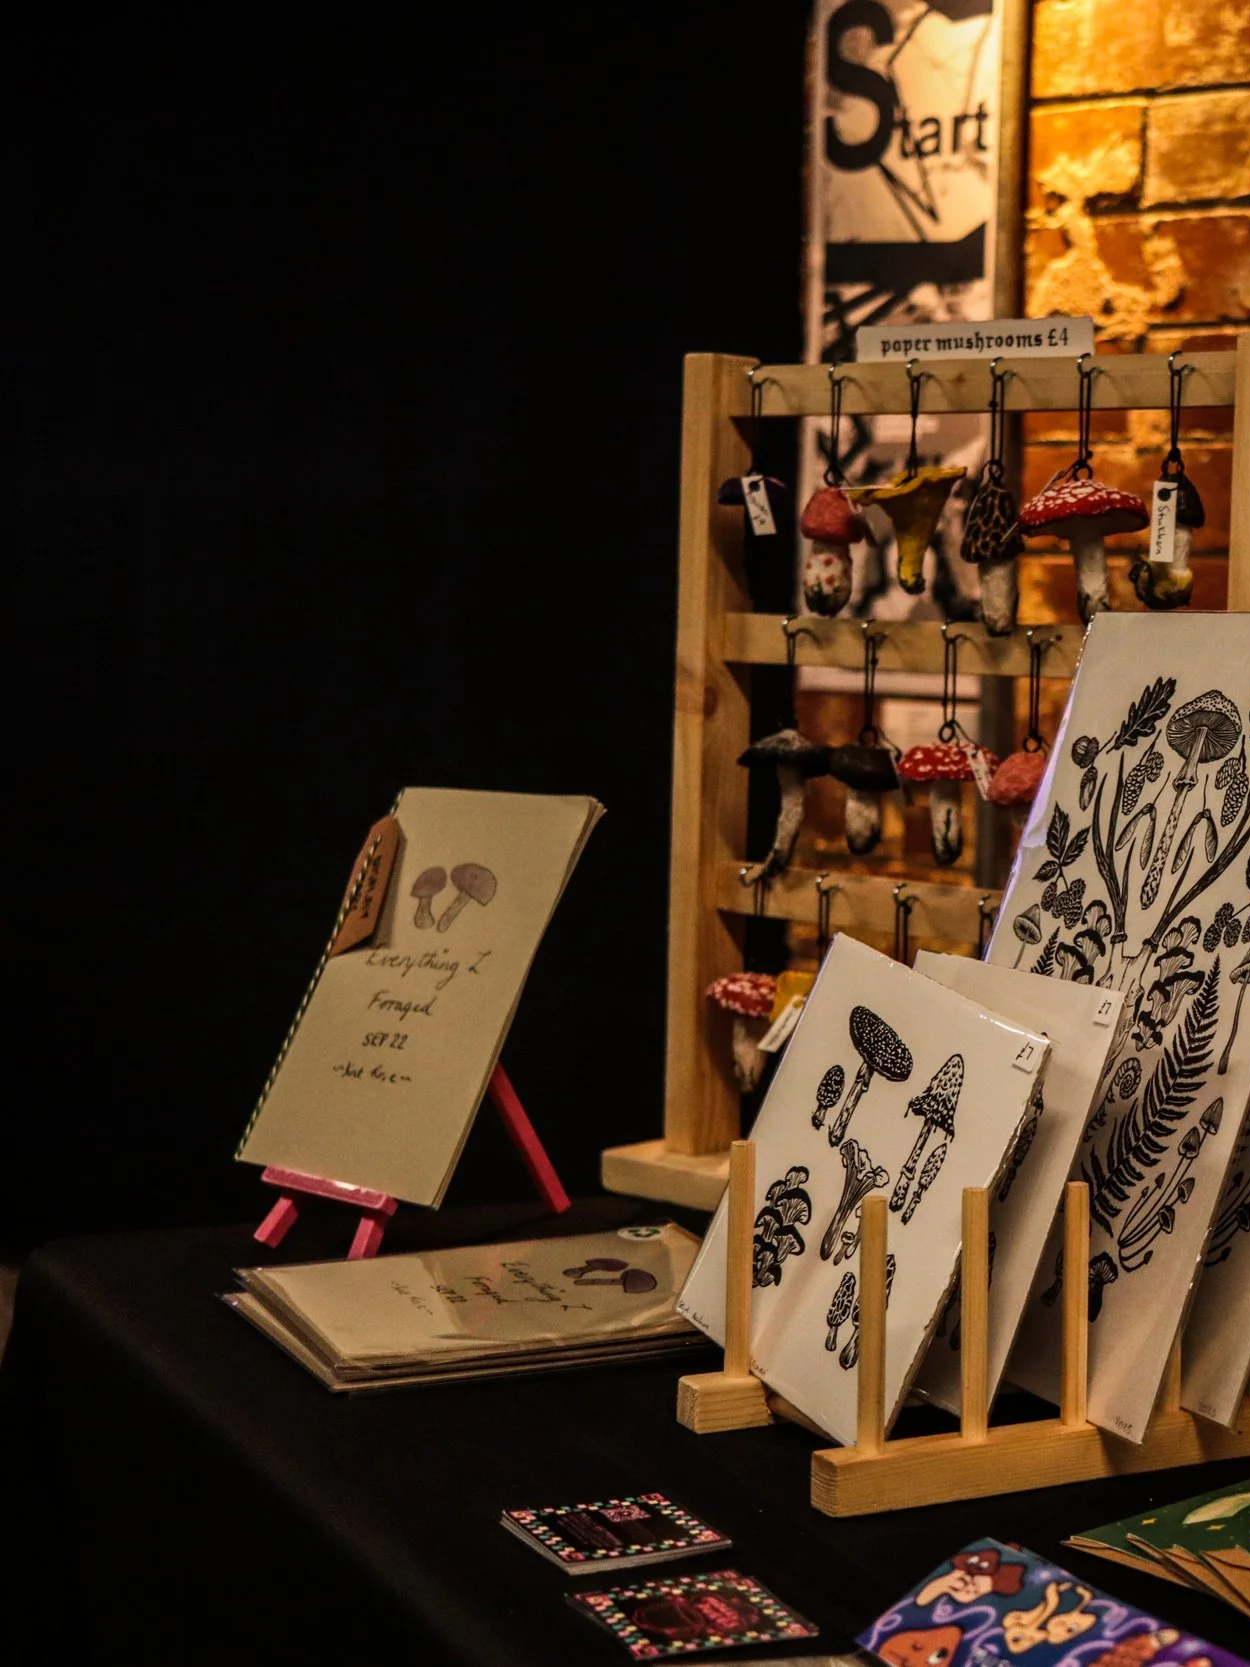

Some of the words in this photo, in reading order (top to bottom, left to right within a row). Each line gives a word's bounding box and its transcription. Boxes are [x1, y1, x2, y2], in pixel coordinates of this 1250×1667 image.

[825, 0, 988, 173] Start
[881, 338, 932, 357] paper
[936, 332, 1043, 352] mushrooms
[1048, 328, 1069, 347] £4
[363, 942, 459, 990] Everything
[367, 989, 437, 1022] Foraged
[1098, 999, 1112, 1015] £7
[389, 1032, 408, 1050] 22
[1015, 1041, 1034, 1061] £7
